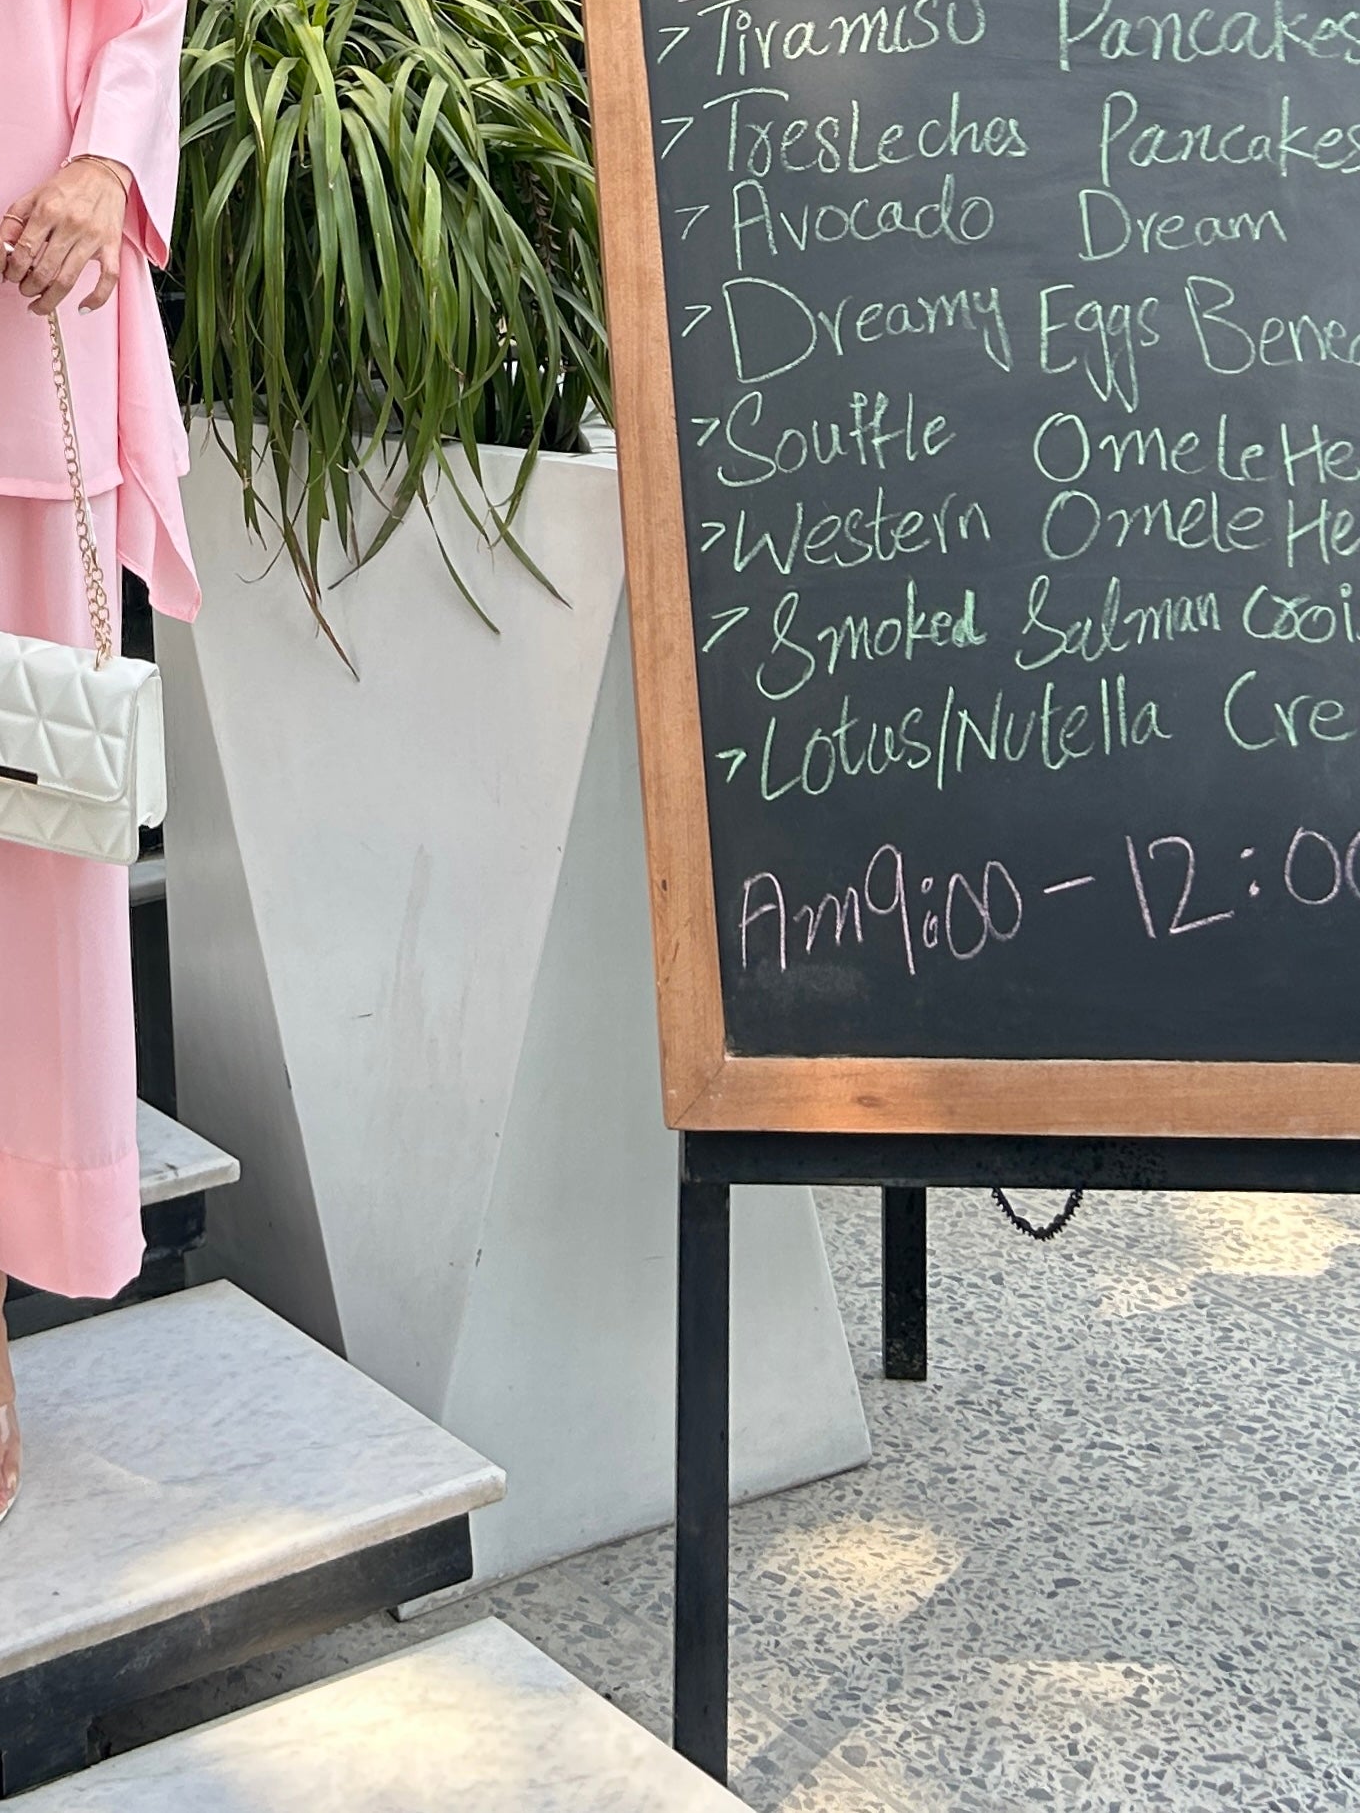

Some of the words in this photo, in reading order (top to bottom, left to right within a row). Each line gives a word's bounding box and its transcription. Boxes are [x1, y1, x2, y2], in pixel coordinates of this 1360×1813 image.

[732, 173, 995, 271] Avocado
[1078, 189, 1288, 262] Dream
[722, 276, 1015, 384] Dreamy
[1040, 284, 1162, 413] Eggs
[717, 390, 958, 487] Souffle
[733, 486, 992, 575] Western
[756, 577, 988, 701] Smoked
